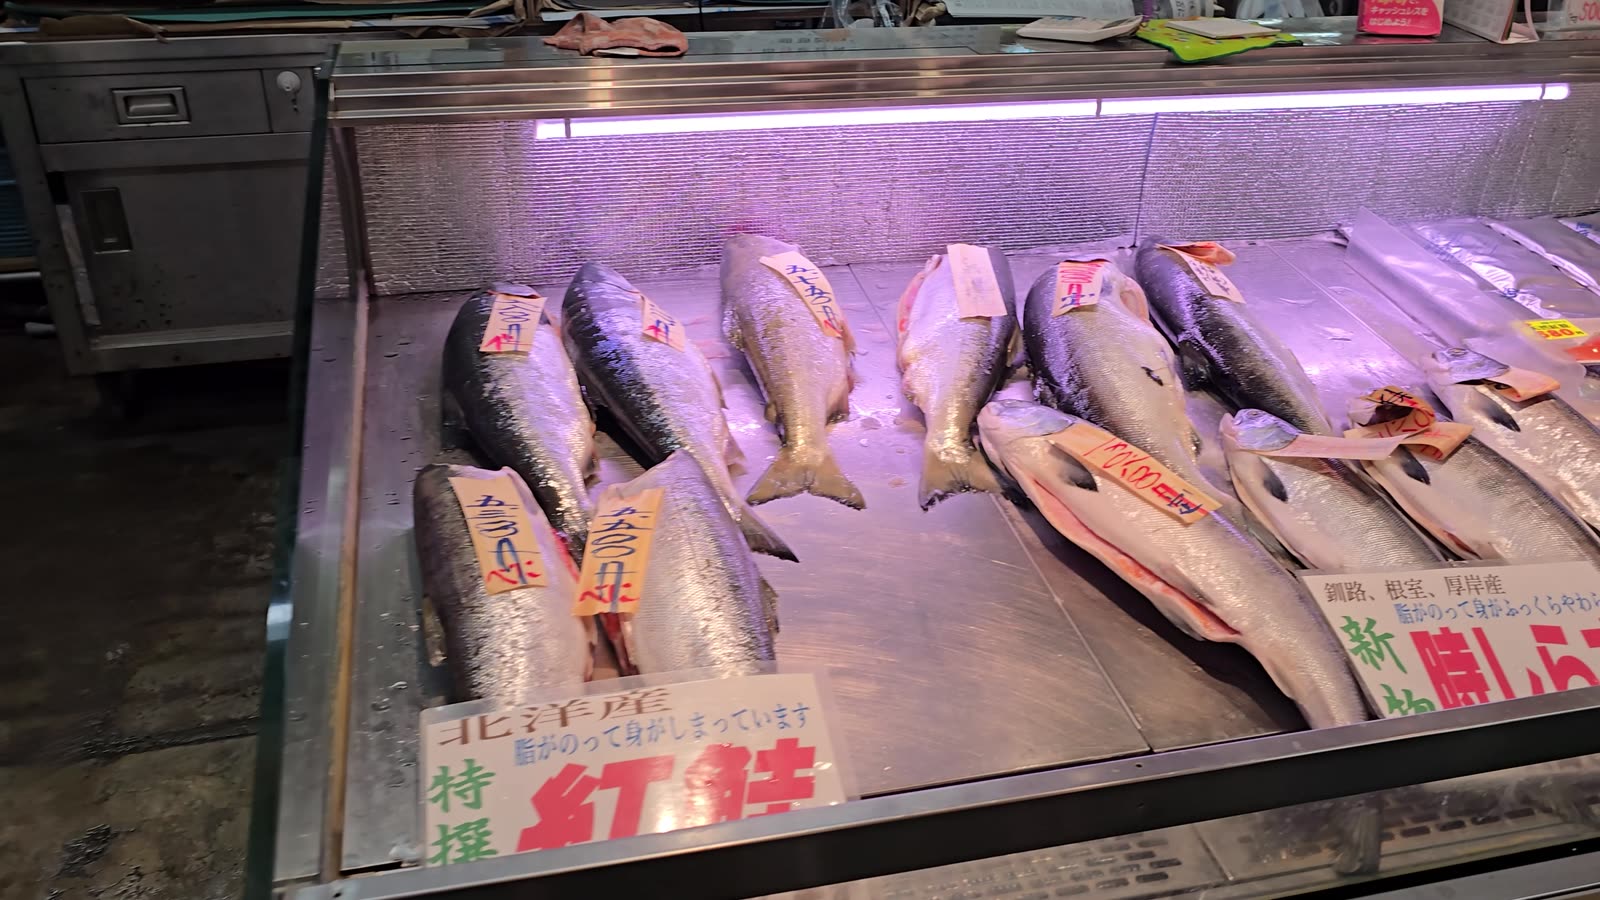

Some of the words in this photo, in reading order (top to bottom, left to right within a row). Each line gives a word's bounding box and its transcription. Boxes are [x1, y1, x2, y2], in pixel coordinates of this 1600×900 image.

[1370, 7, 1429, 16] キャッシュレスを
[1324, 574, 1506, 602] 釧路、根室、厚岸産
[438, 688, 672, 746] 北洋産
[514, 703, 810, 767] 脂がのって身がしまっています
[516, 737, 816, 853] 紅鮭
